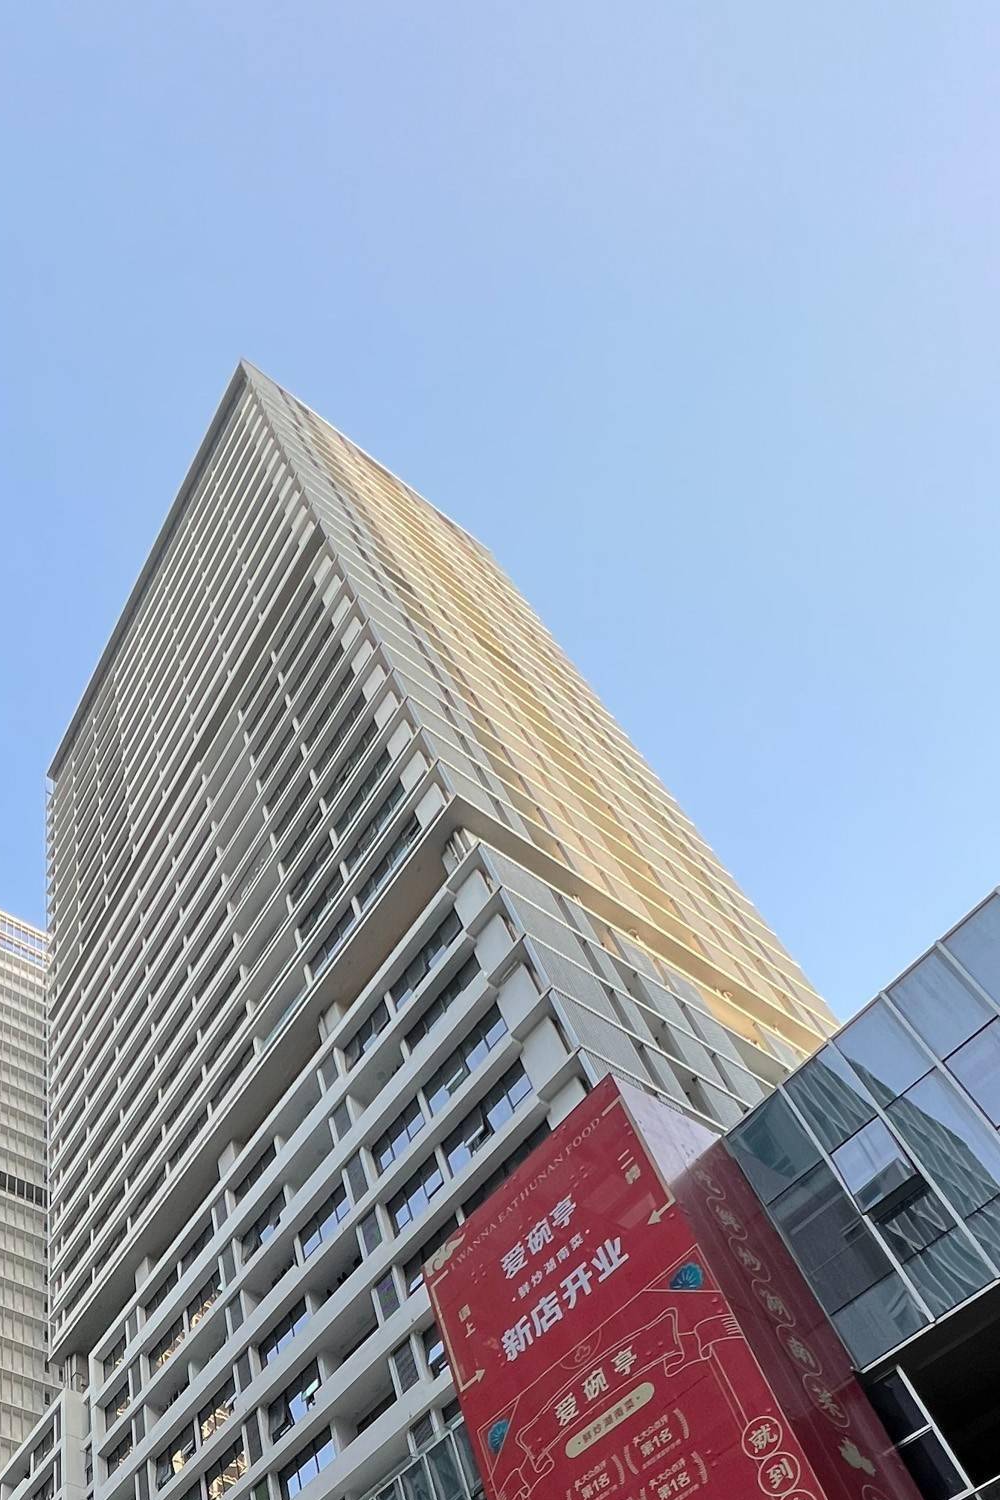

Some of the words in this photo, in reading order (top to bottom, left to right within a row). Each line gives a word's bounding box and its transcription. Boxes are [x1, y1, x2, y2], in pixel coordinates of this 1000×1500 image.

[455, 1222, 498, 1265] WANNA
[565, 1117, 601, 1156] FOOD
[500, 1193, 577, 1280] 爱碗亭
[500, 1236, 630, 1362] 新店开业
[554, 1344, 638, 1427] 爱碗亭
[640, 1427, 673, 1458] 第1名
[580, 1472, 611, 1500] 第1名
[657, 1471, 691, 1500] 第1名
